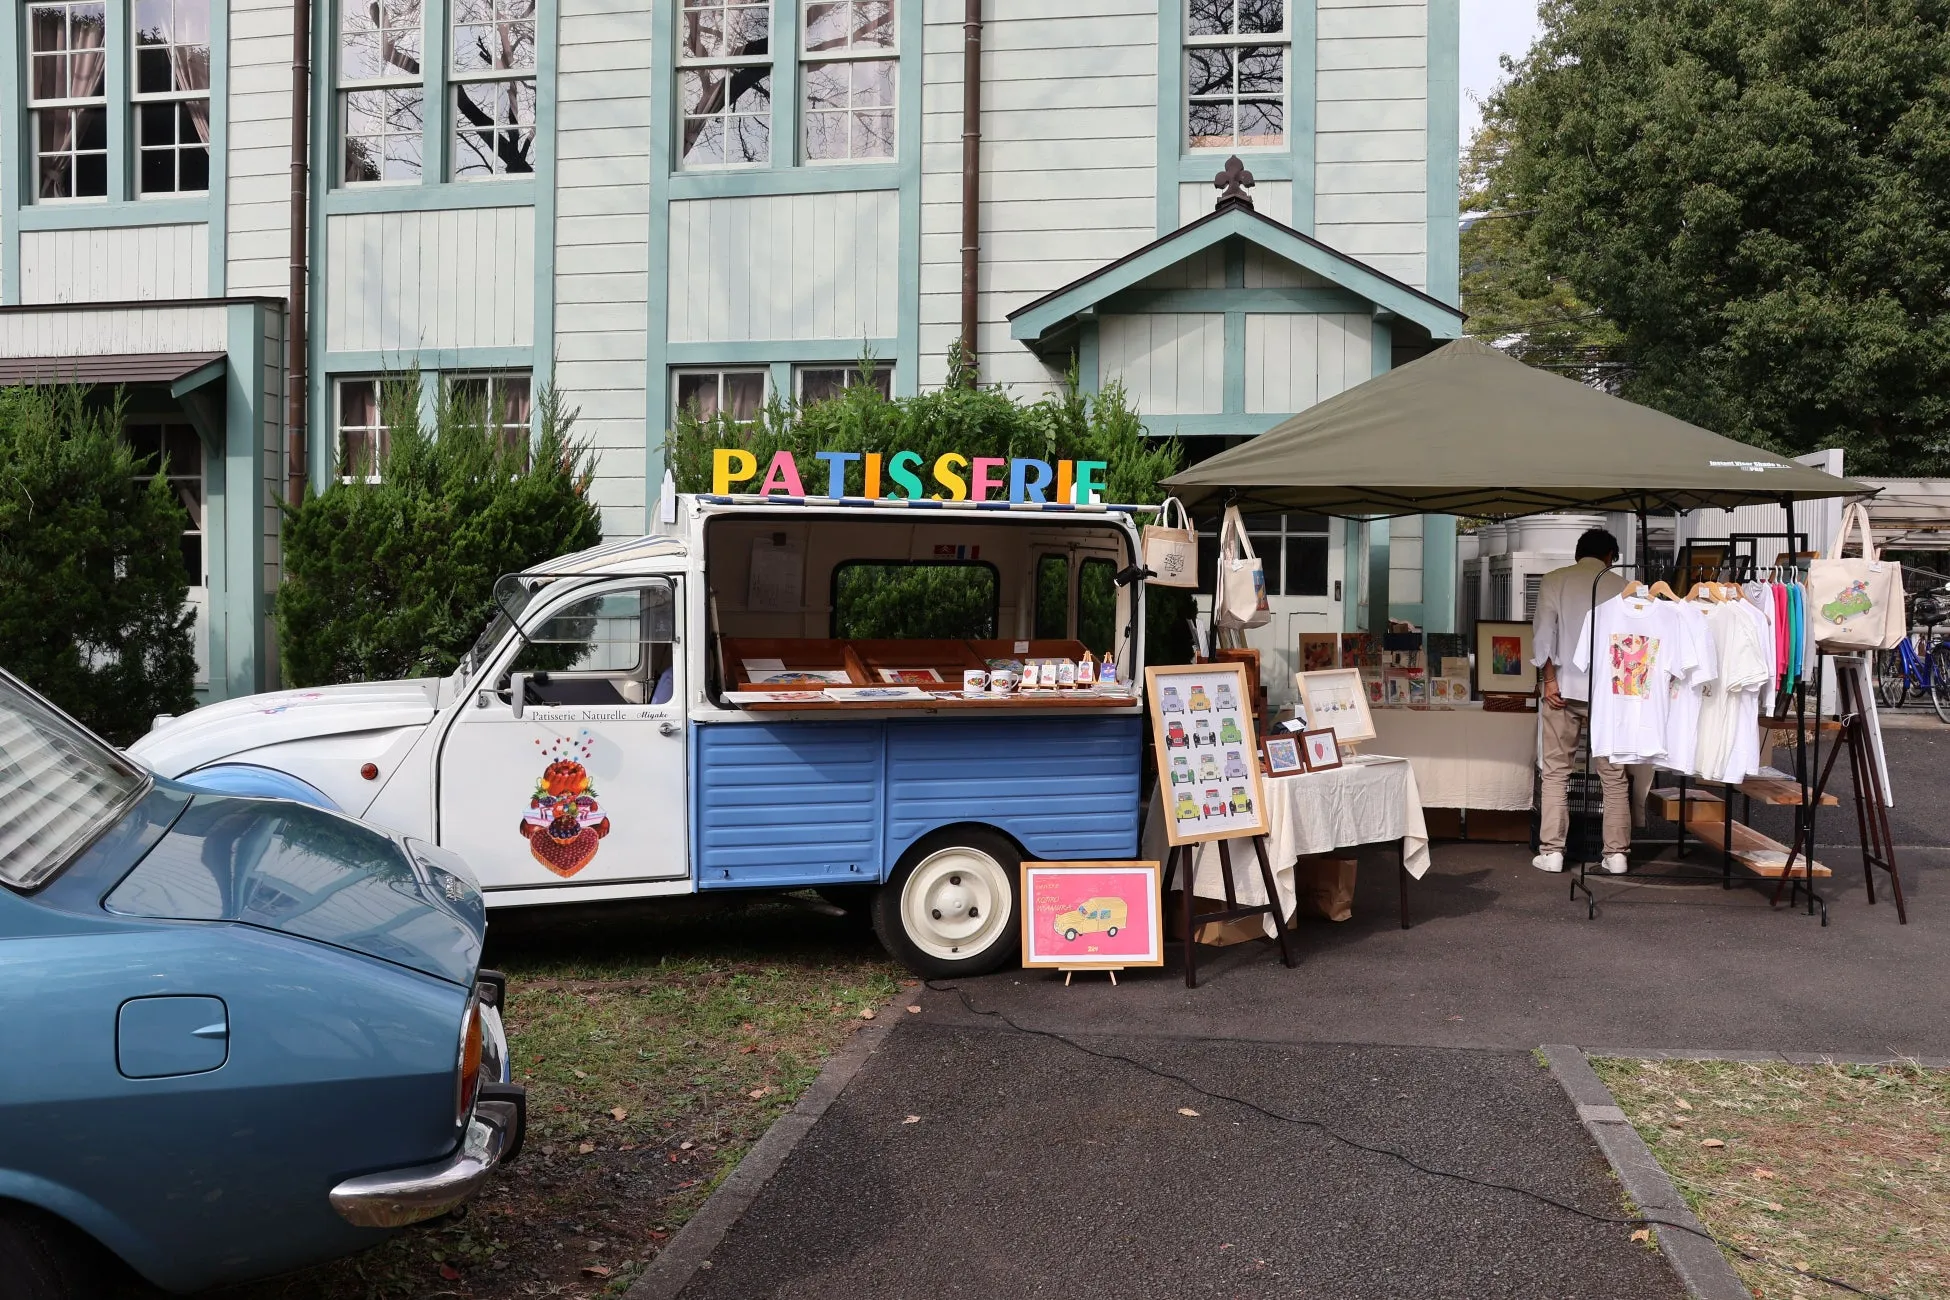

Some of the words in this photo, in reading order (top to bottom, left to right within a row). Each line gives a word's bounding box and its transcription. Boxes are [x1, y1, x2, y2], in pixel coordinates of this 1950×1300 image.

[713, 448, 1107, 505] PATISSERIE
[532, 711, 575, 720] Patisserie
[582, 710, 626, 720] Naturelle
